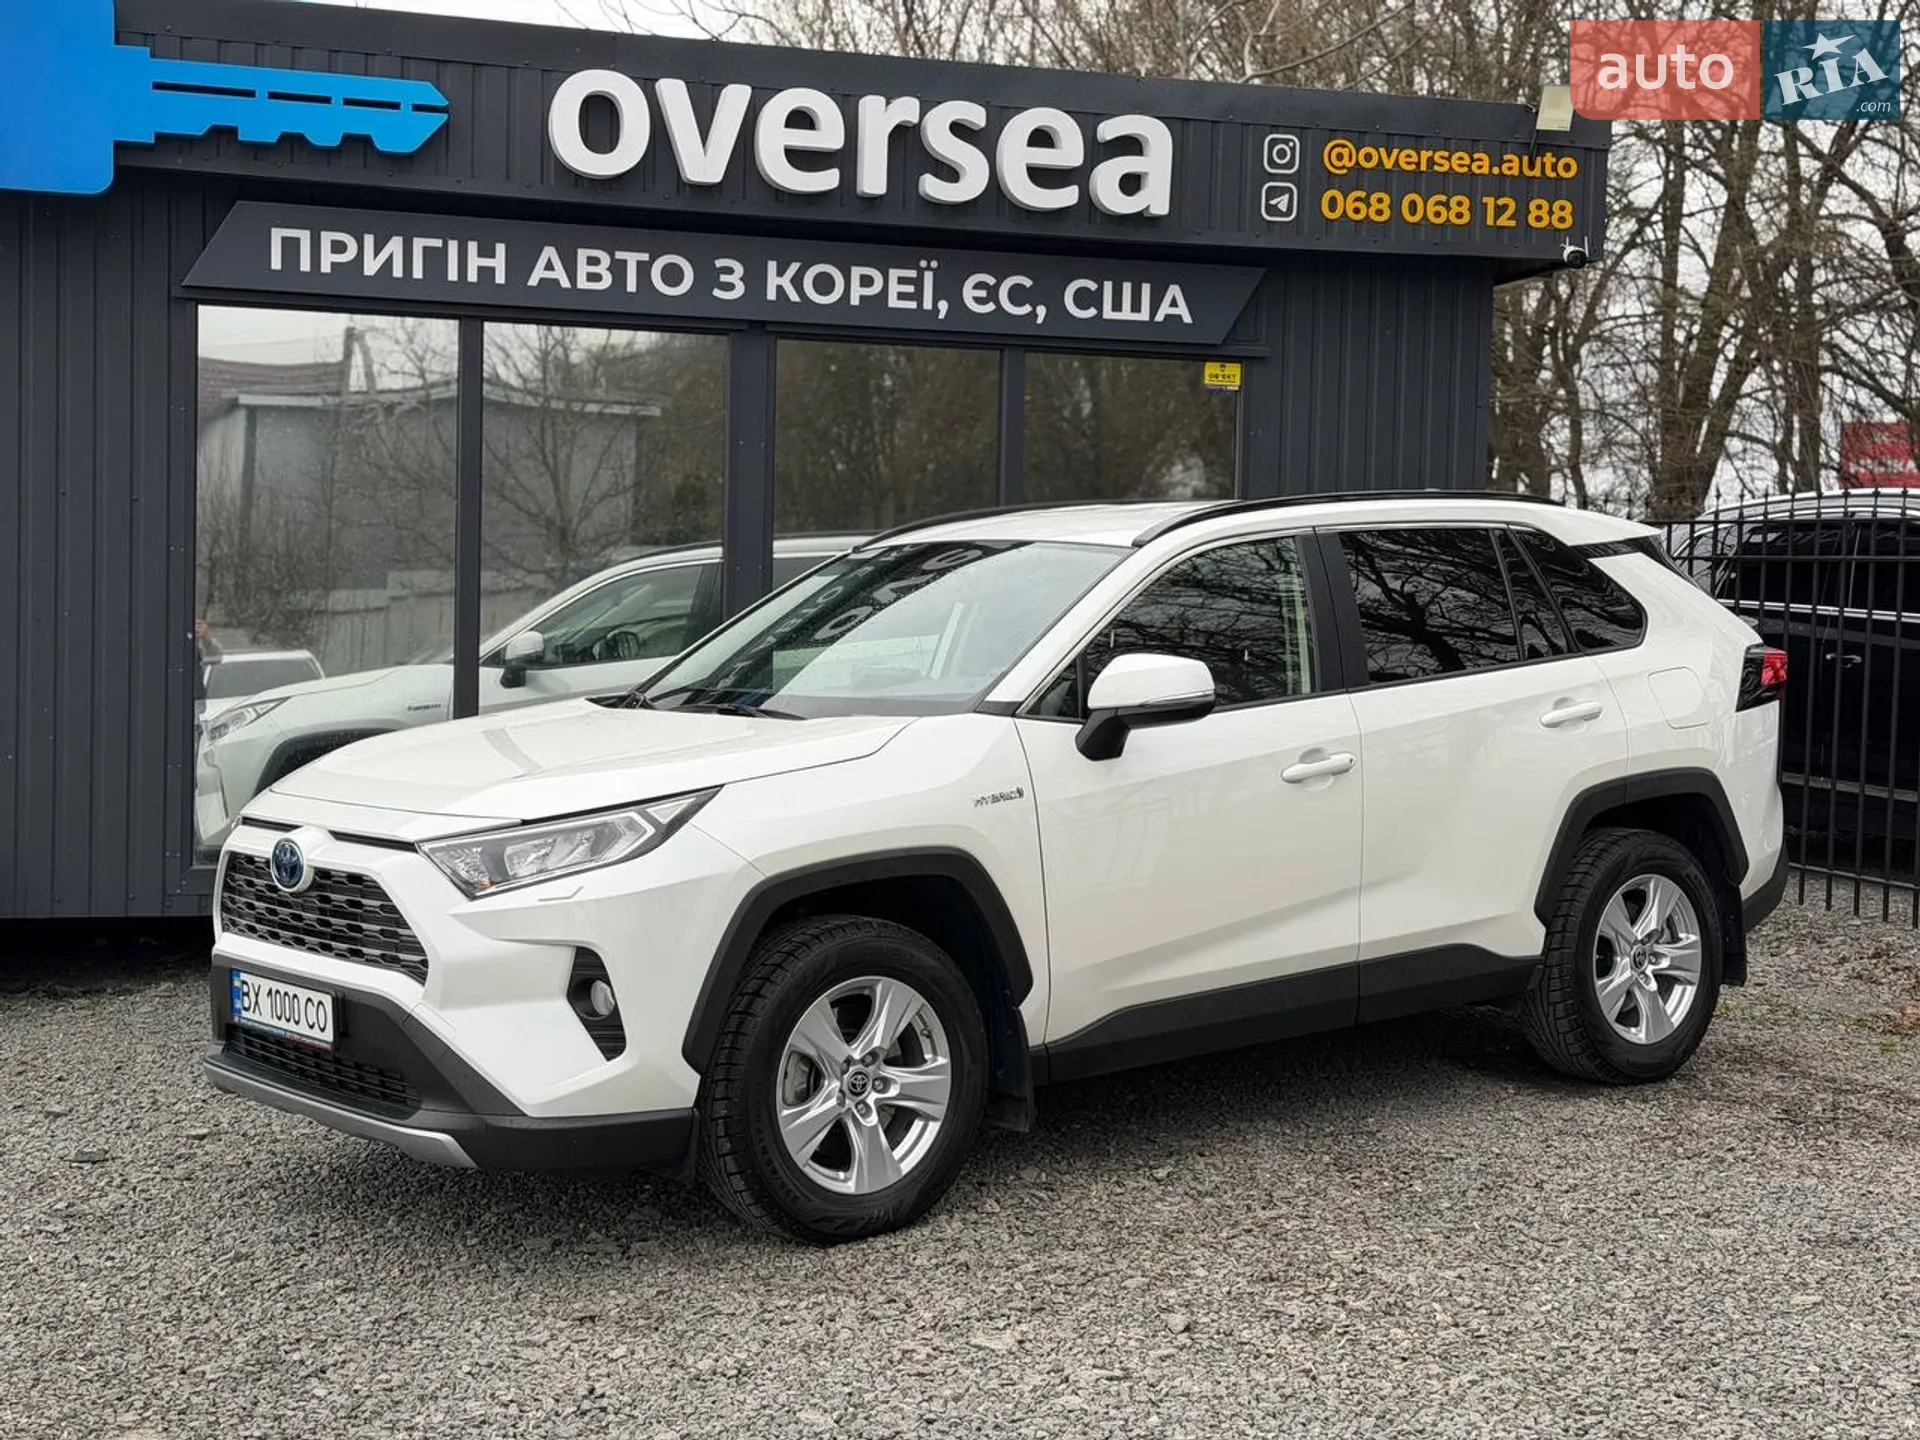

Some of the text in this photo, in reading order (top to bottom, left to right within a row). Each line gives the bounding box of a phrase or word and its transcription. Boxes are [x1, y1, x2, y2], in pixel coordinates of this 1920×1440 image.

[549, 69, 1173, 216] oversea
[1322, 138, 1578, 179] @oversea.auto
[1320, 189, 1574, 230] 068 068 12 88
[269, 227, 1193, 324] ПРИГІН АВТО З КОРЕЇ, ЄС, США
[242, 980, 328, 1033] BX 1000 CO
